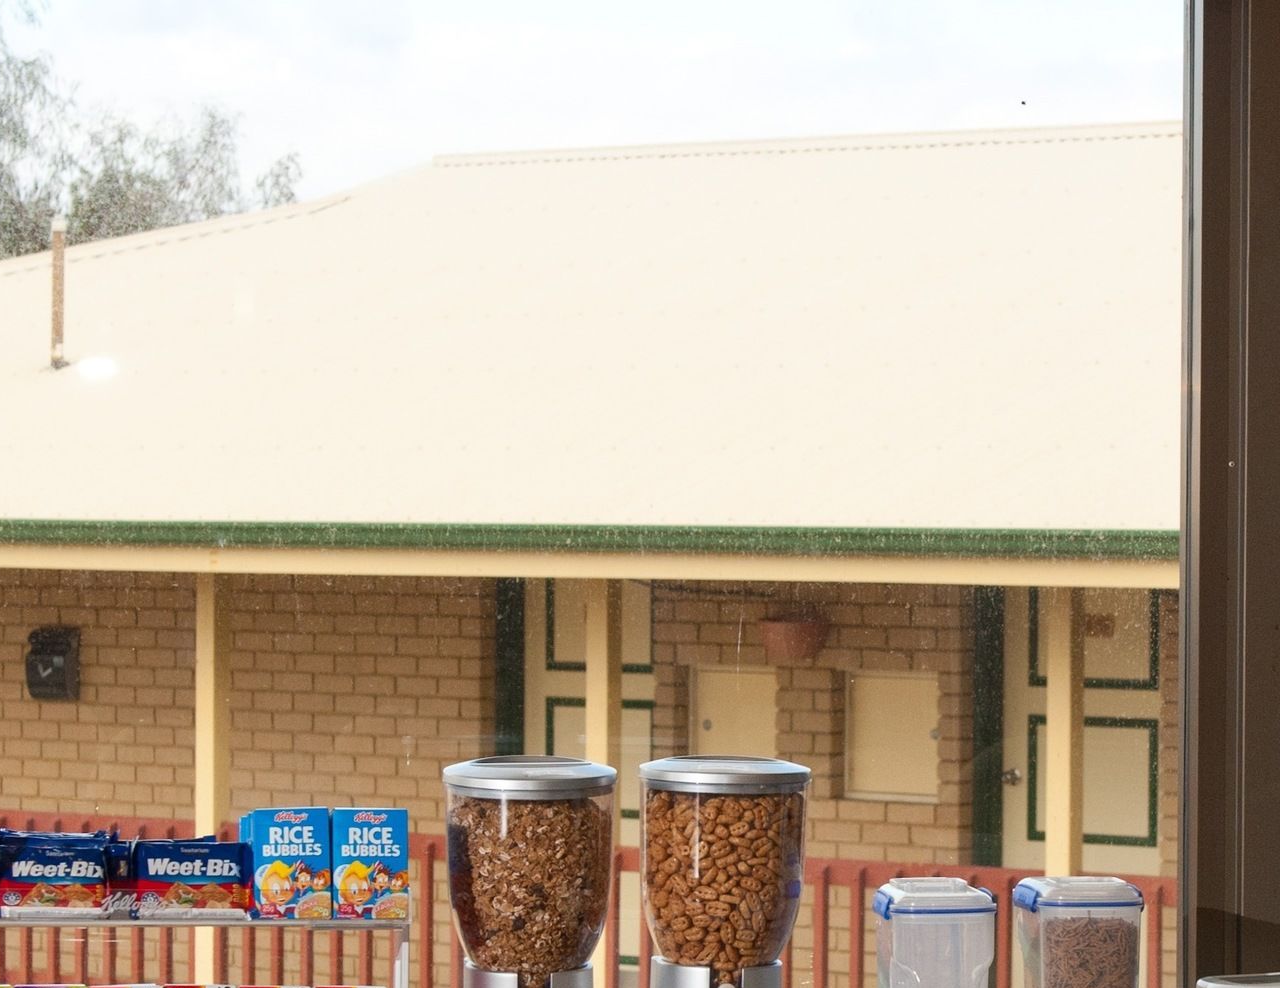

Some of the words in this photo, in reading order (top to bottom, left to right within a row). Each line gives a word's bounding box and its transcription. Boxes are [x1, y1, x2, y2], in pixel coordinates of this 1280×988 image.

[274, 811, 308, 823] Kellogg's
[354, 811, 388, 824] Kellogg's
[269, 826, 315, 844] RICE
[348, 827, 393, 845] RICE
[262, 843, 322, 857] BUBBLES
[341, 844, 400, 857] BUBBLES
[12, 860, 105, 878] Weet-Bix
[147, 858, 240, 877] Weet-Bix
